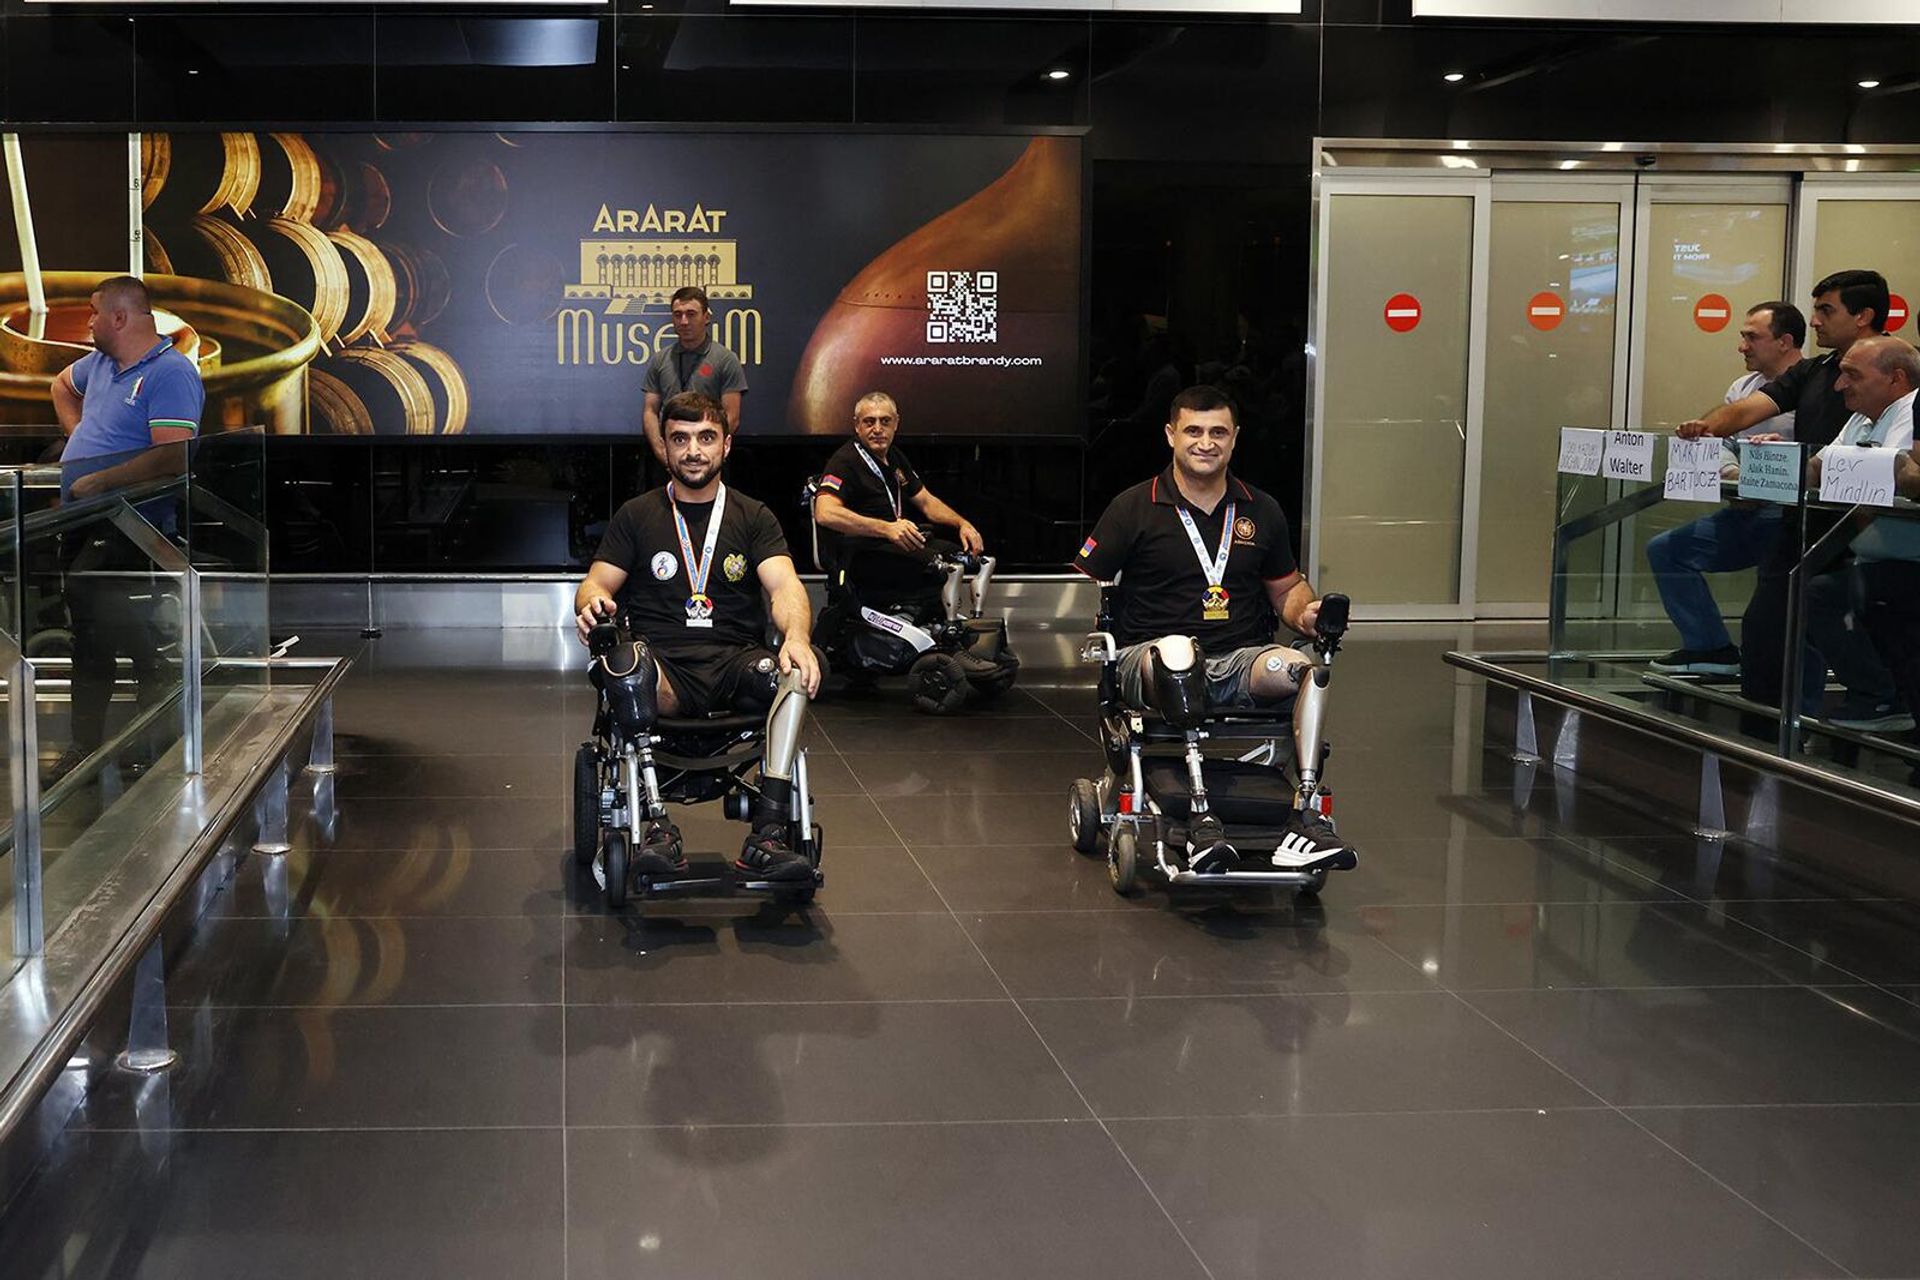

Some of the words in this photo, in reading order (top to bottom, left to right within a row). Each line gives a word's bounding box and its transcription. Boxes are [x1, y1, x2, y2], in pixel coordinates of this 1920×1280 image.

[592, 203, 727, 233] ARARAT
[880, 356, 1042, 367] www.araratbrandy.com
[1614, 432, 1645, 446] Anton
[1671, 442, 1720, 464] MARTINA
[1609, 457, 1643, 475] Walter
[1823, 475, 1886, 503] Mindlin
